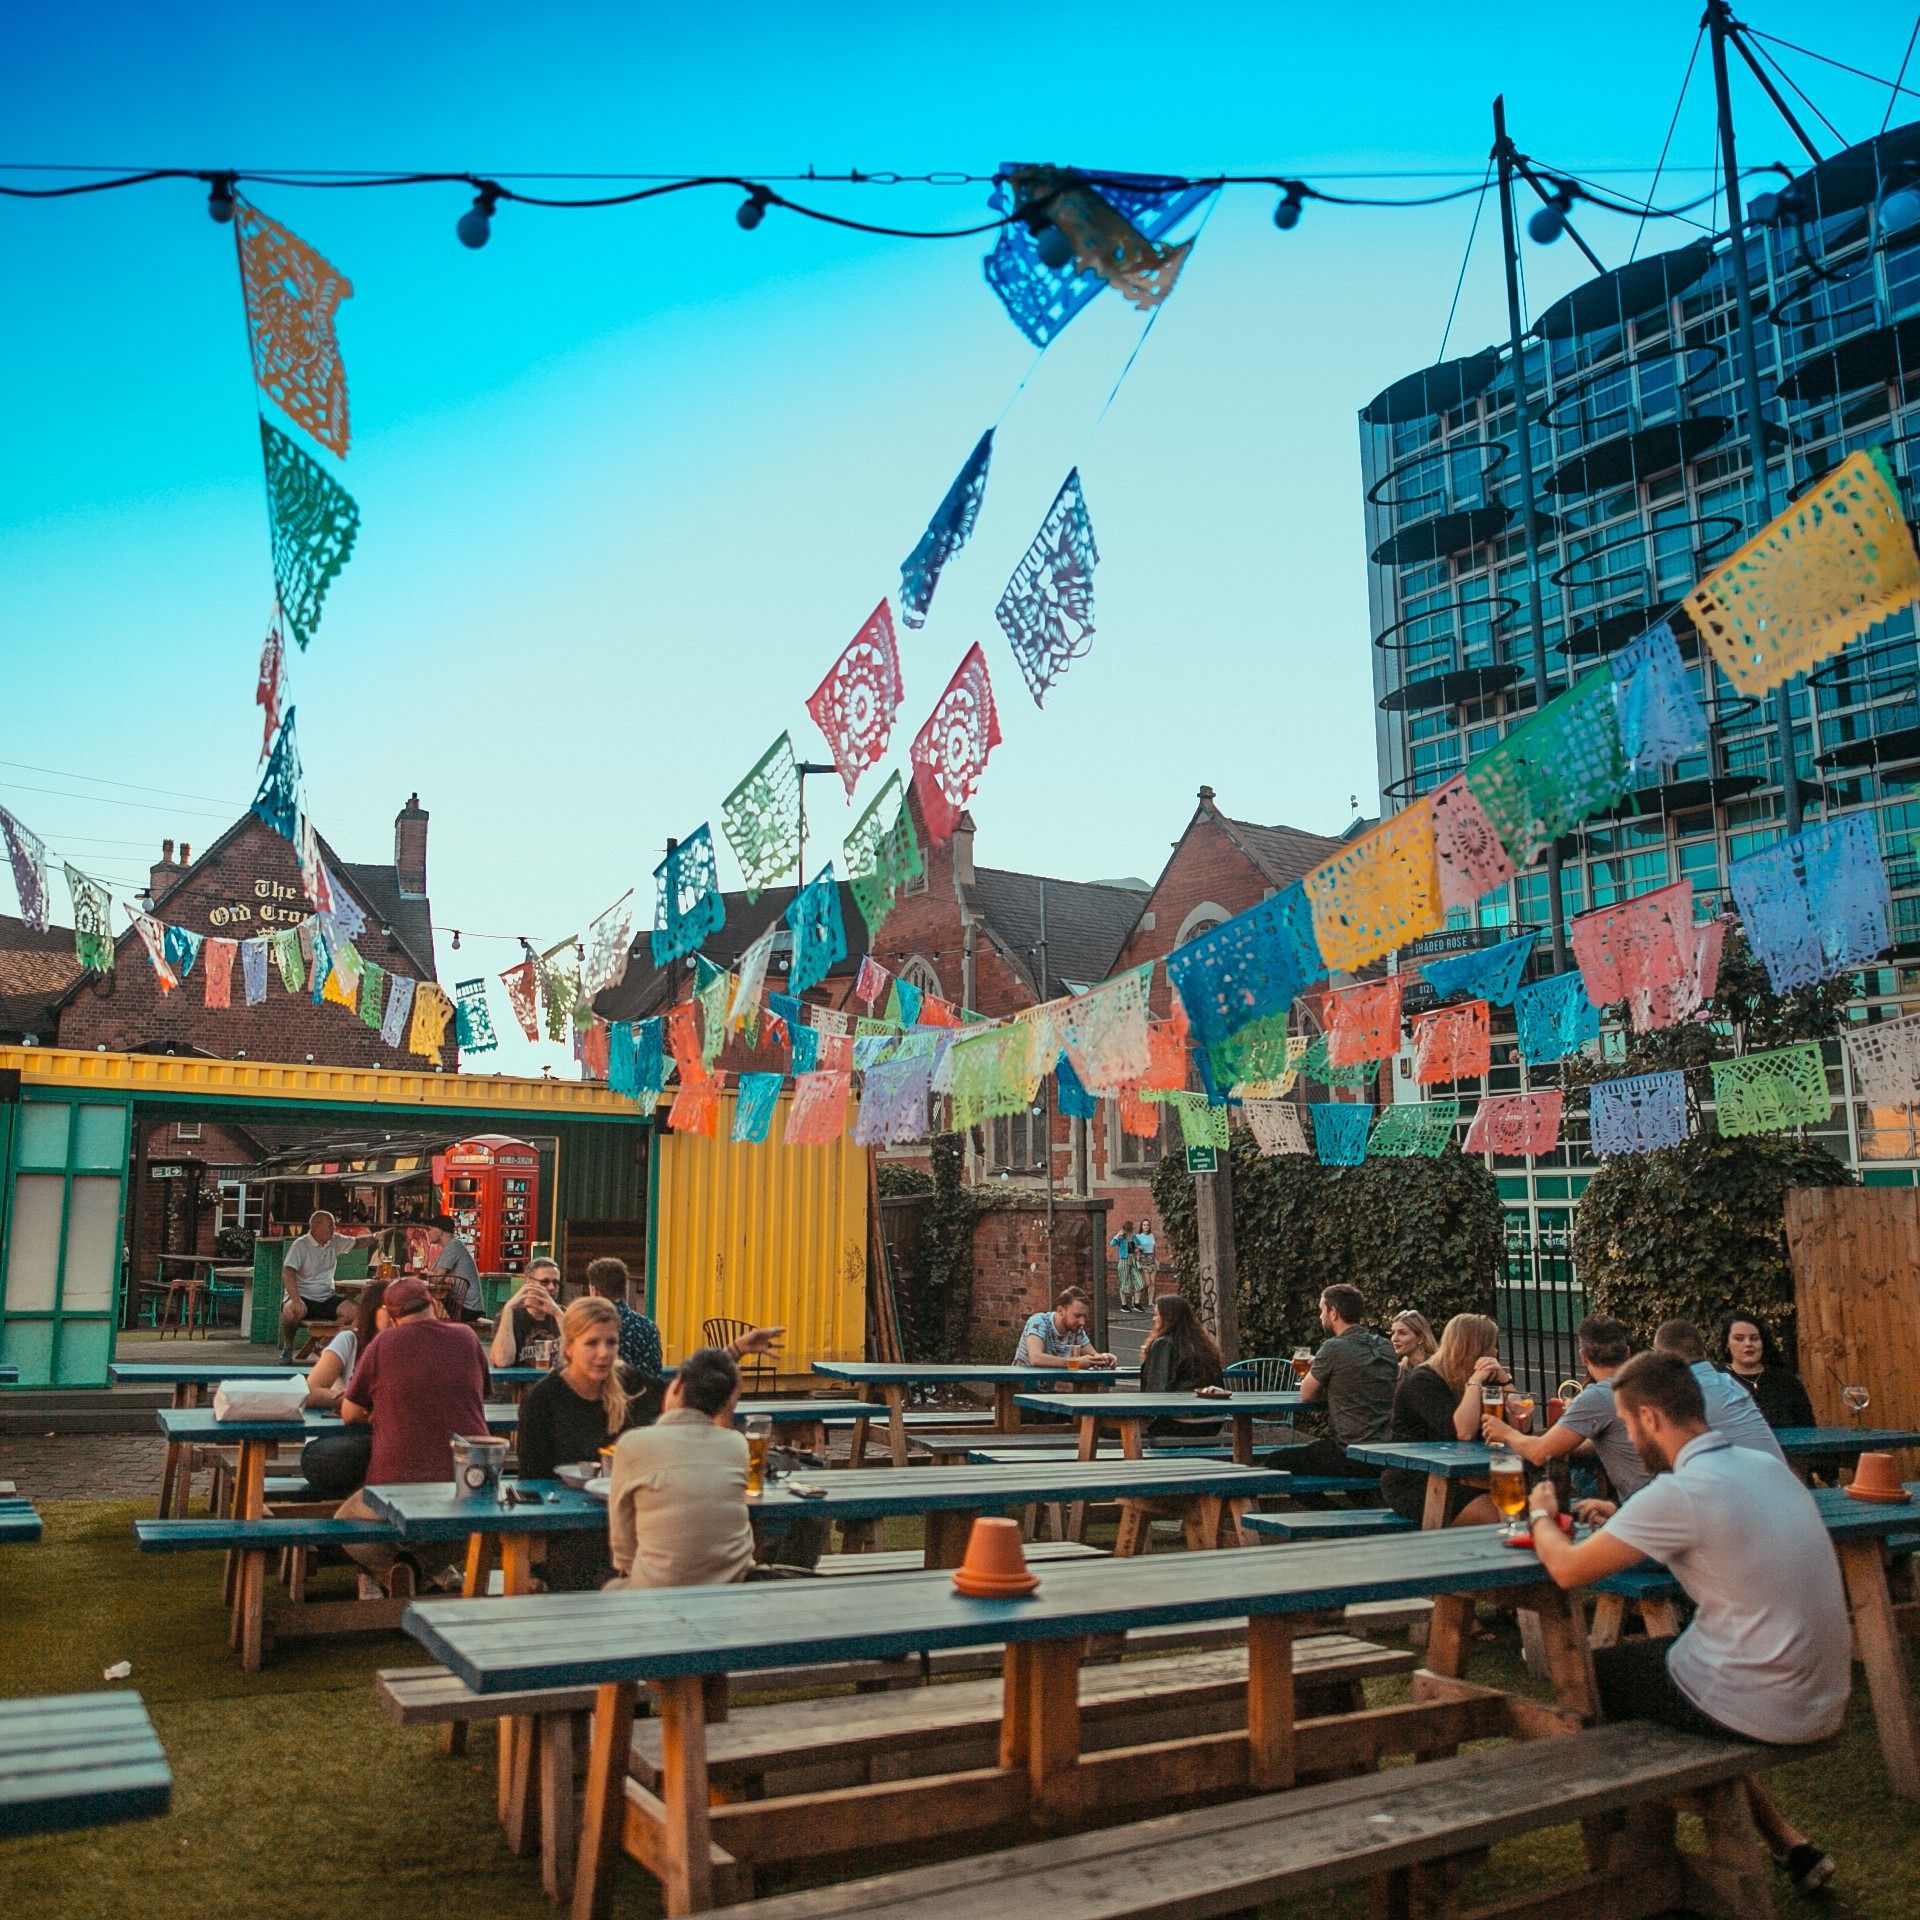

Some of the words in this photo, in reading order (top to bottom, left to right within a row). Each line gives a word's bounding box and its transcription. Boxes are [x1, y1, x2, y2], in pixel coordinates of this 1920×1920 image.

[254, 879, 297, 901] The
[1415, 940, 1444, 955] SHADED
[1446, 936, 1468, 949] ROSE
